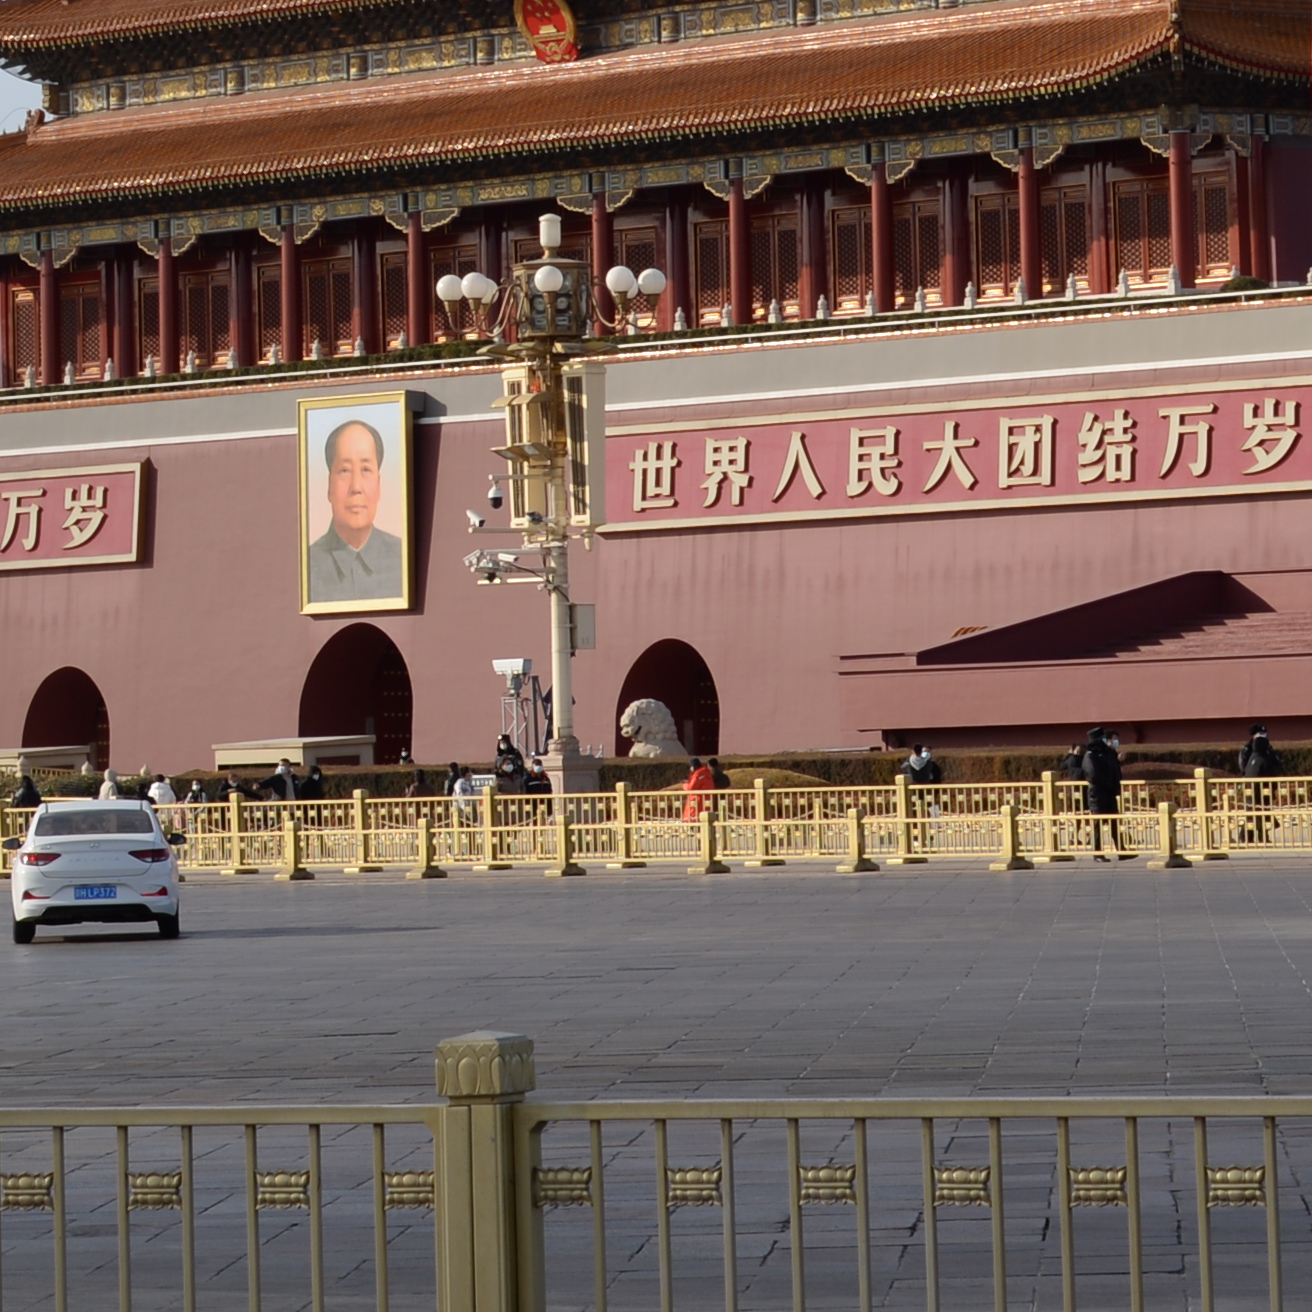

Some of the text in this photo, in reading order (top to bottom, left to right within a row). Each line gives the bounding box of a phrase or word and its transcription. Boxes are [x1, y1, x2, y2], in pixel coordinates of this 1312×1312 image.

[629, 399, 1300, 511] 世界人民大团结万岁
